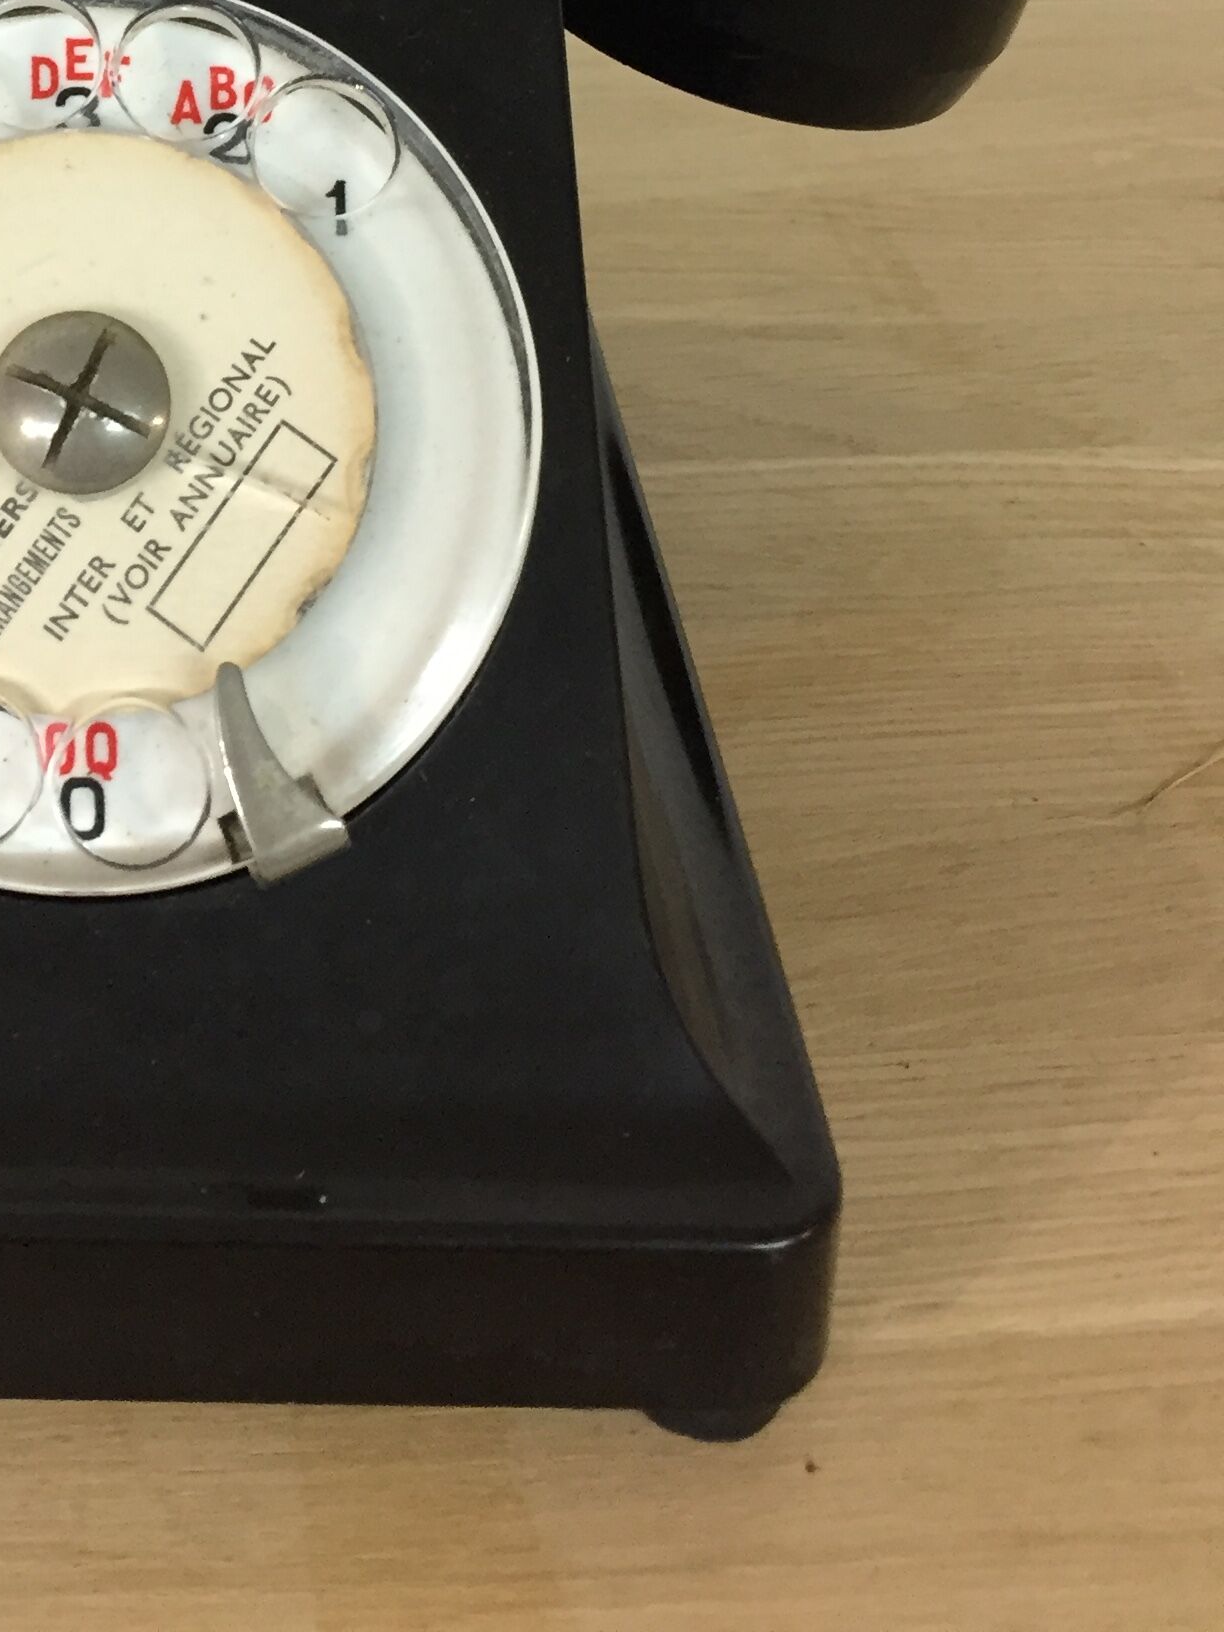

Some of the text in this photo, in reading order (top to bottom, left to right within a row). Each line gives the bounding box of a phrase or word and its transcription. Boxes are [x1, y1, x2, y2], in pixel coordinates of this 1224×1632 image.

[203, 112, 252, 164] 2
[325, 179, 348, 236] 1
[102, 376, 292, 625] (VOIR ANNUAIRE)
[43, 555, 116, 642] INTER
[120, 491, 157, 534] ET
[59, 776, 106, 841] 0
